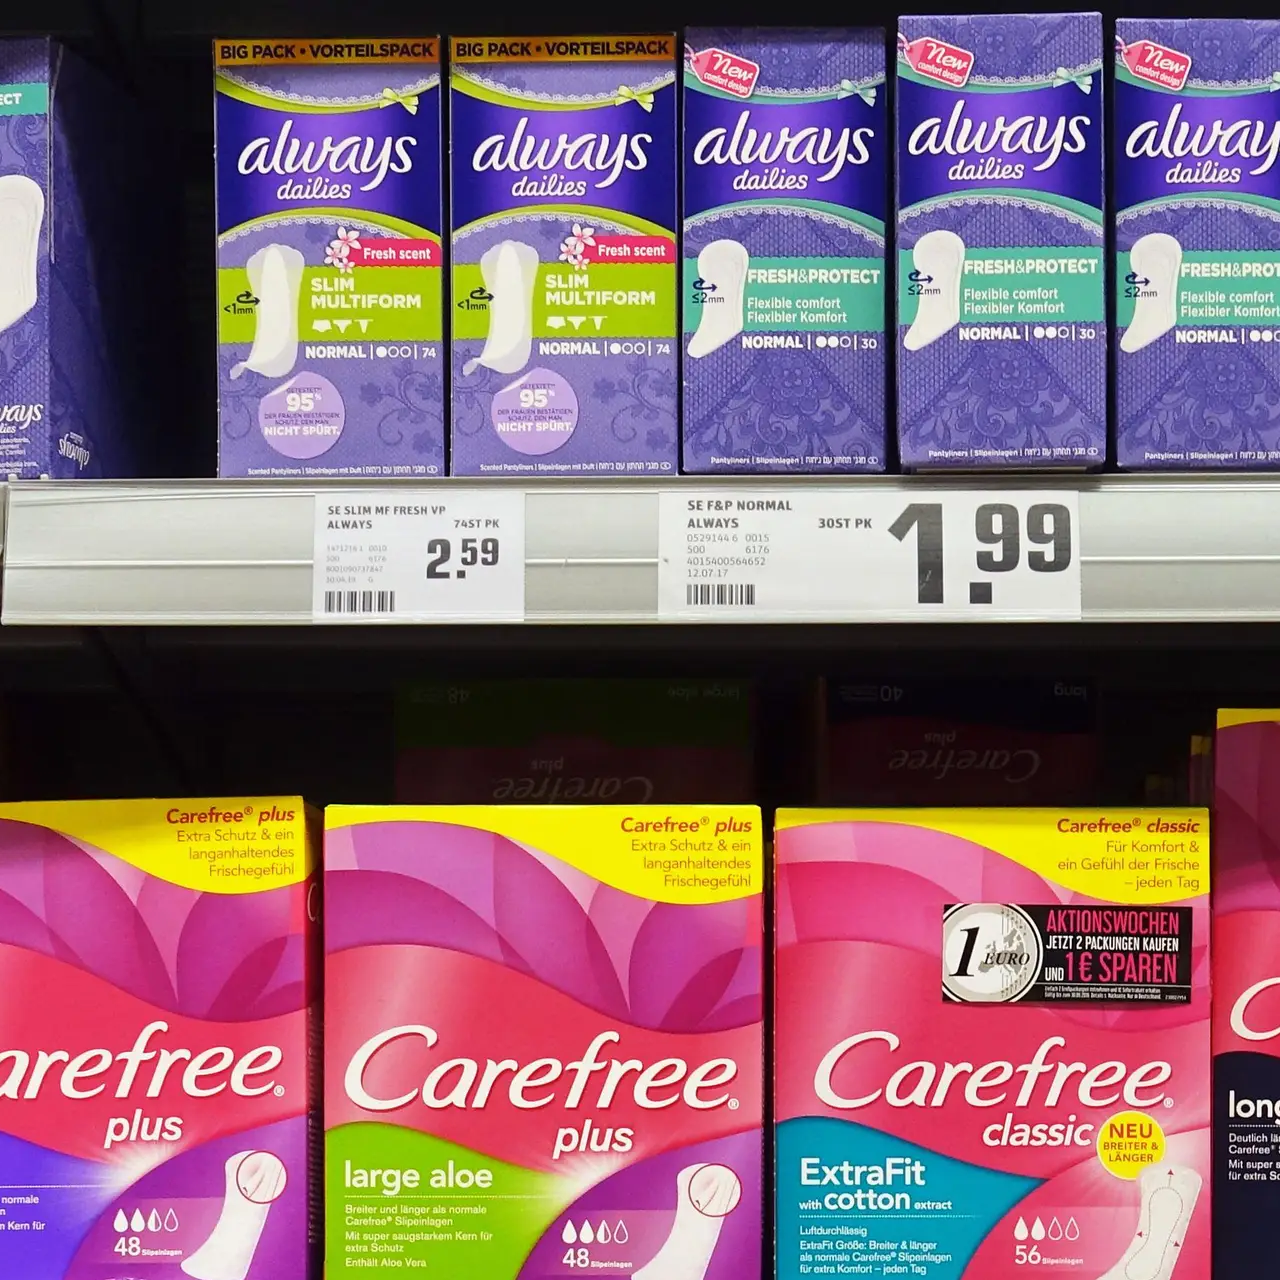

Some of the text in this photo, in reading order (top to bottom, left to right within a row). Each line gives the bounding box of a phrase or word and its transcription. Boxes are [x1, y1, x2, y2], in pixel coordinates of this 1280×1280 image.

[221, 42, 434, 59] BIG PACK VORTEILSPACK
[929, 48, 968, 71] New
[909, 101, 1091, 171] always
[238, 120, 417, 191] always
[949, 159, 1025, 180] dailies
[311, 277, 354, 292] SLIM
[311, 293, 421, 309] MULTIFORM
[426, 539, 500, 580] 2.59
[888, 504, 1072, 605] 1.99
[1107, 841, 1199, 852] Für Komfort &
[1058, 858, 1199, 870] ein Gefühl der Frische
[1046, 910, 1179, 934] AKTIONSWOCHEN
[1046, 935, 1178, 951] JETZT 2 PACKUNGEN KAUFEN
[1045, 952, 1176, 983] UND 1 € SPAREN
[344, 1025, 739, 1110] Carefree
[1109, 1121, 1154, 1140] NEU
[1103, 1142, 1146, 1152] BREITER
[1108, 1151, 1154, 1163] LÄNGER
[344, 1161, 493, 1192] large aloe
[801, 1158, 926, 1186] ExtraFit
[799, 1188, 952, 1211] with cotton extract
